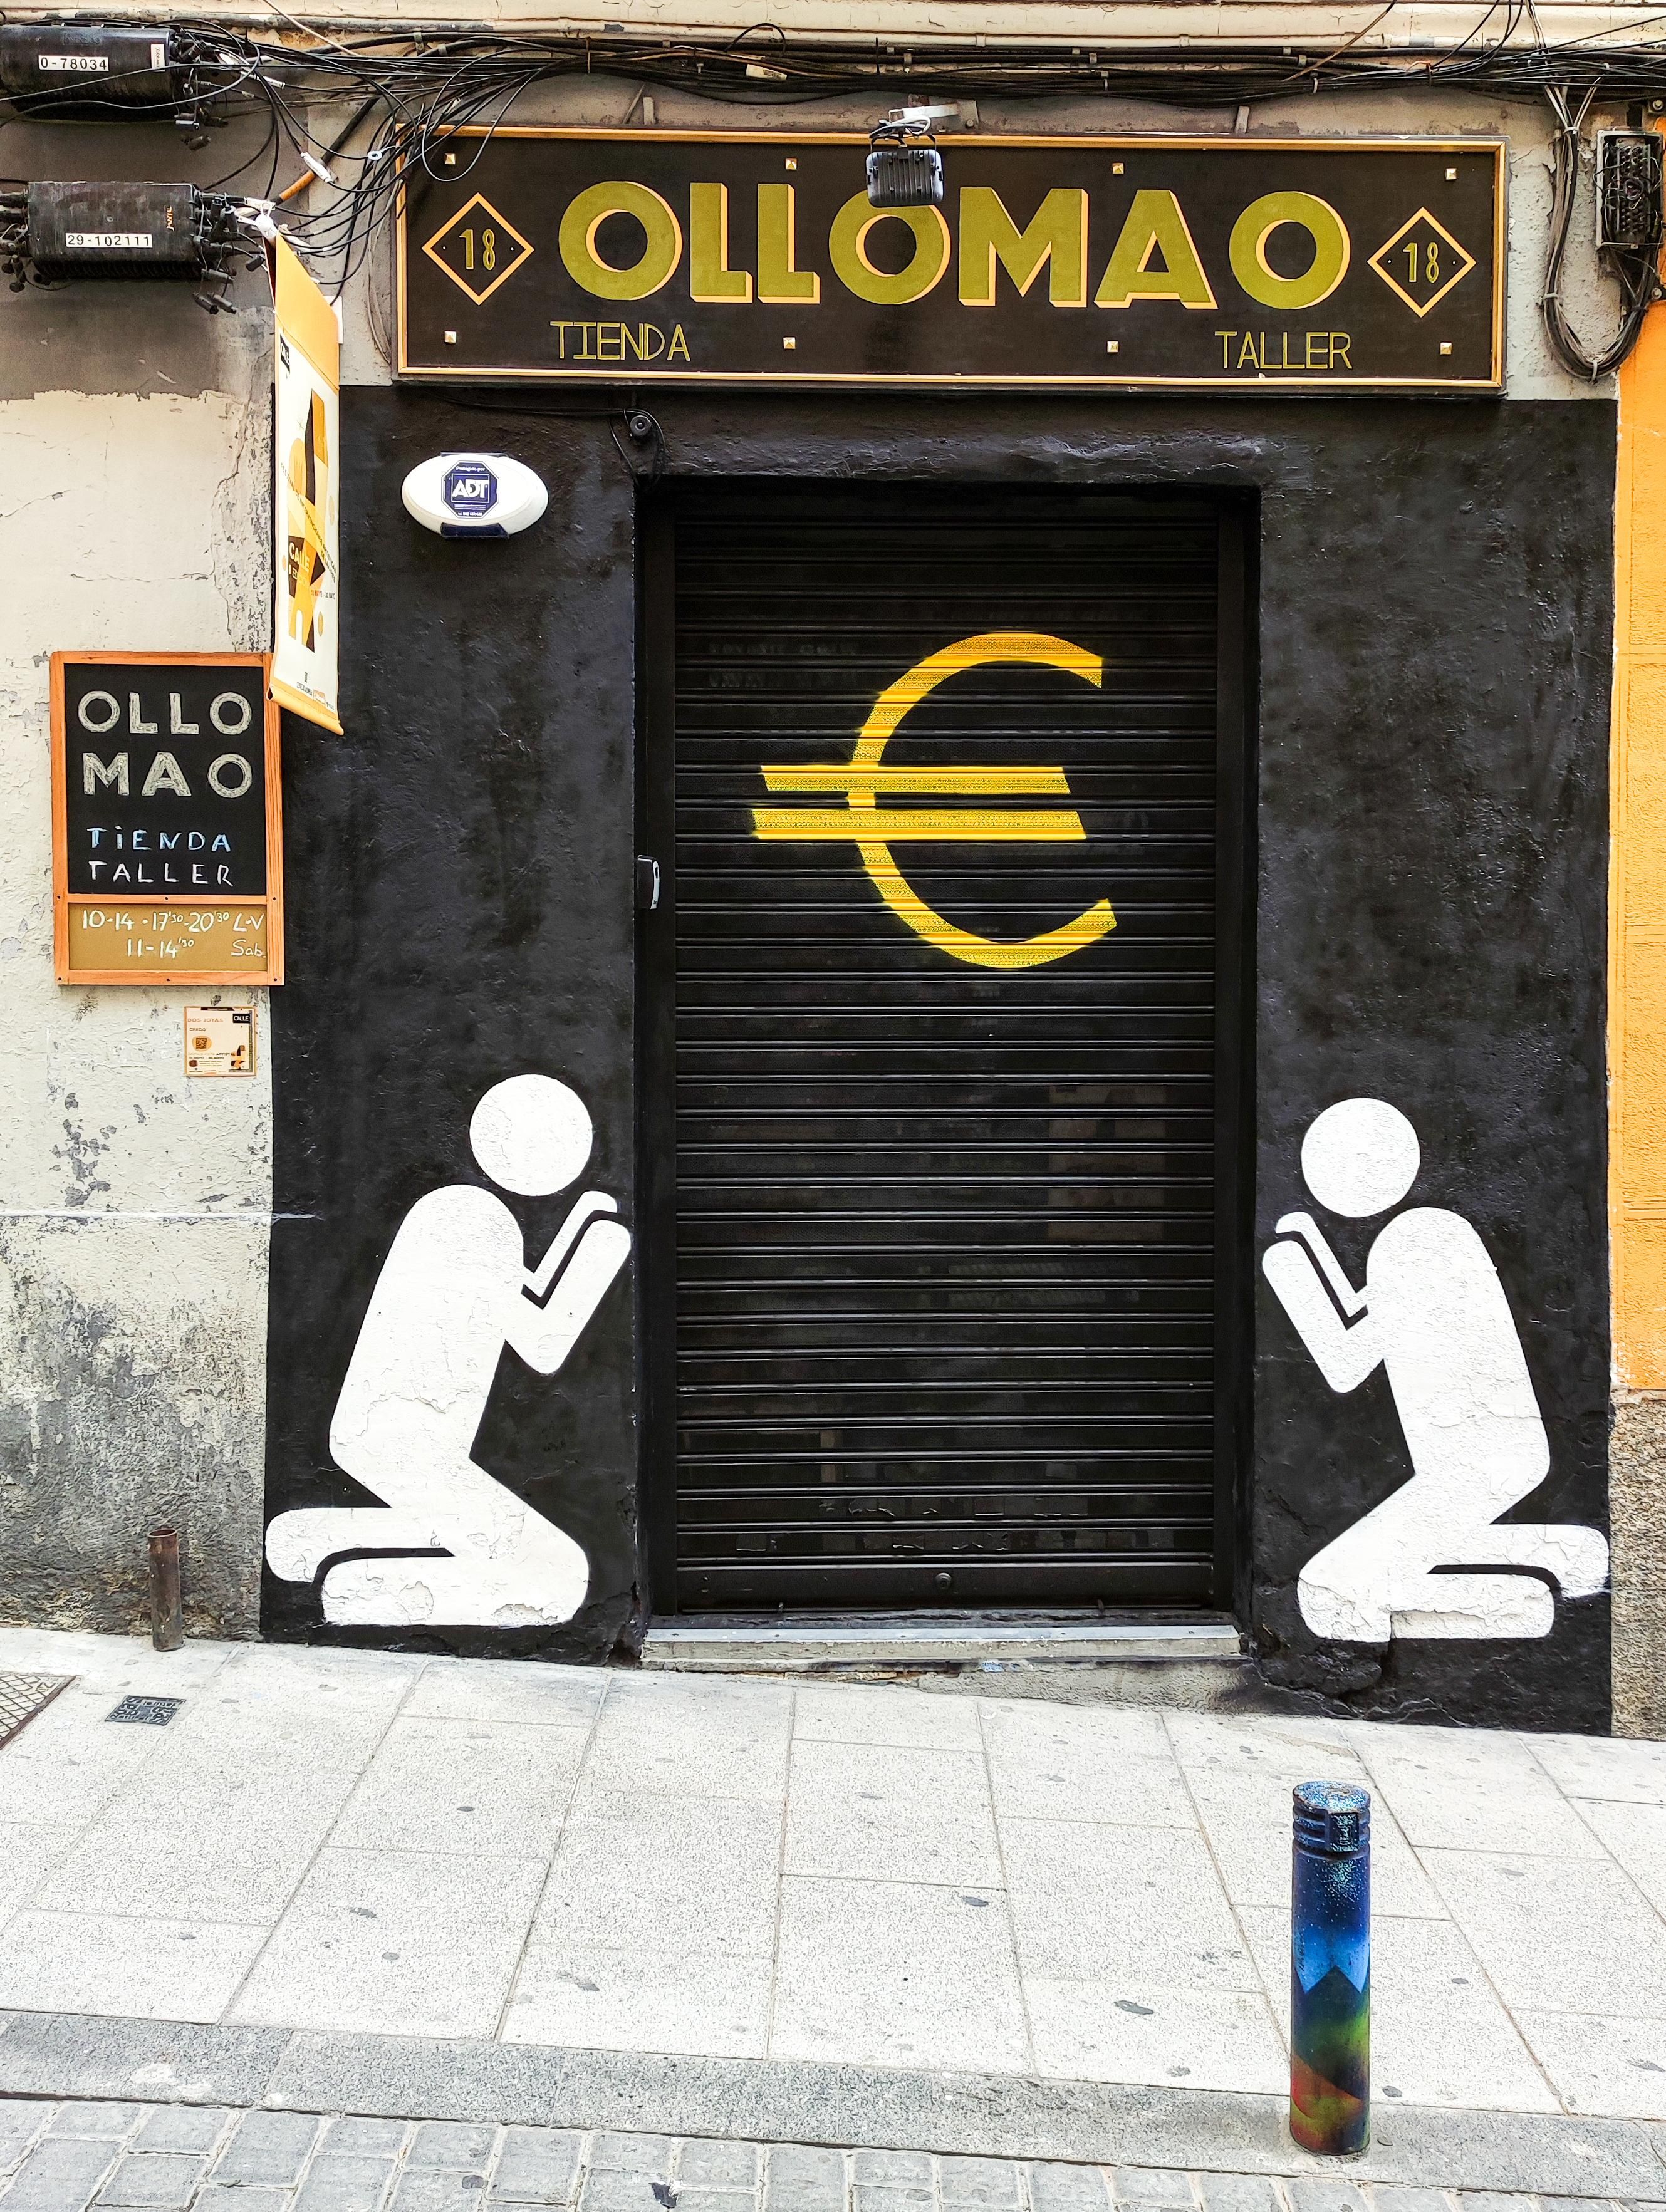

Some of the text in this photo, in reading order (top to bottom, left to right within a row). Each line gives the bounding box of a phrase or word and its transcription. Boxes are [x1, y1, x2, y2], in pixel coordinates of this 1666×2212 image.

[41, 57, 107, 70] 0-78034
[68, 235, 150, 246] 29-102111
[459, 229, 496, 270] 18
[1403, 242, 1439, 283] 18
[550, 321, 690, 361] TIENDA
[1214, 331, 1353, 370] TALLER
[452, 478, 489, 499] ADT
[289, 541, 310, 573] CALLE
[78, 690, 252, 735] OLLO
[83, 752, 253, 799] MAO
[88, 859, 234, 887] TALLER
